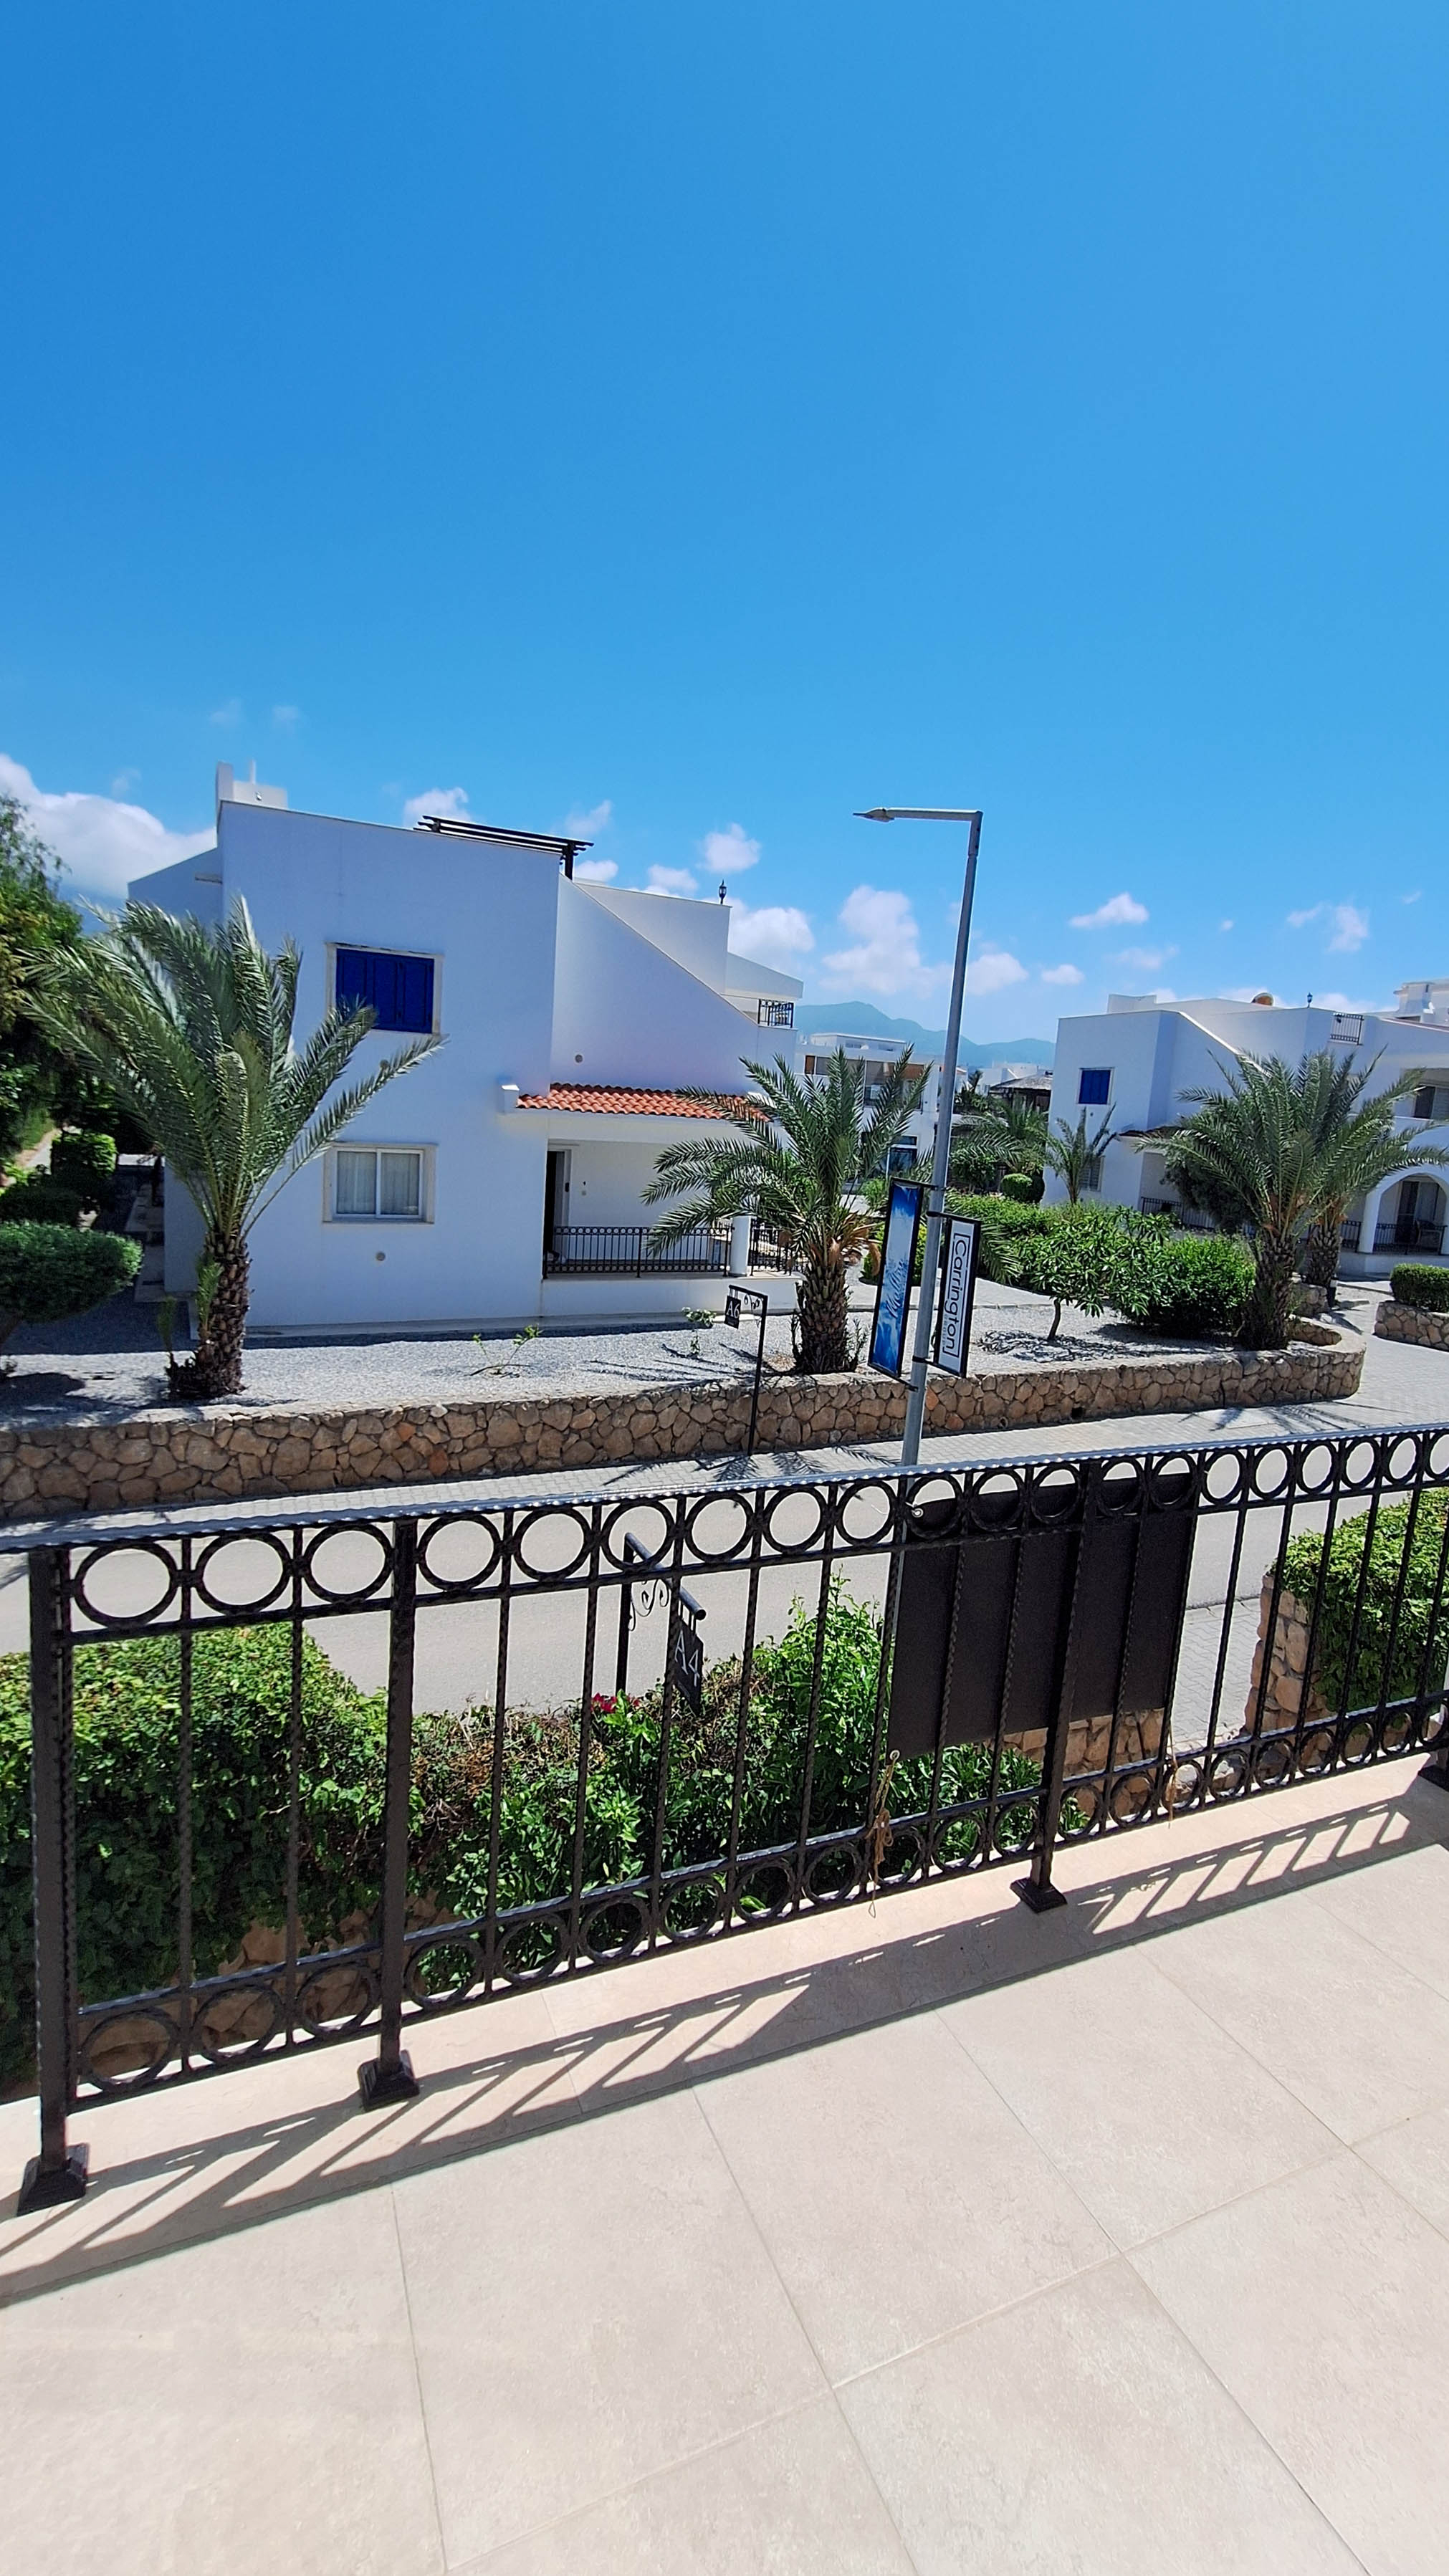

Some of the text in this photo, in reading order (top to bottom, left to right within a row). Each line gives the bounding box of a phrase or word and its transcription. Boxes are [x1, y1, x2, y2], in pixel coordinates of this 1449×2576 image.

[726, 1301, 740, 1318] A6
[944, 1240, 967, 1350] Carrington
[674, 1629, 700, 1687] A4
